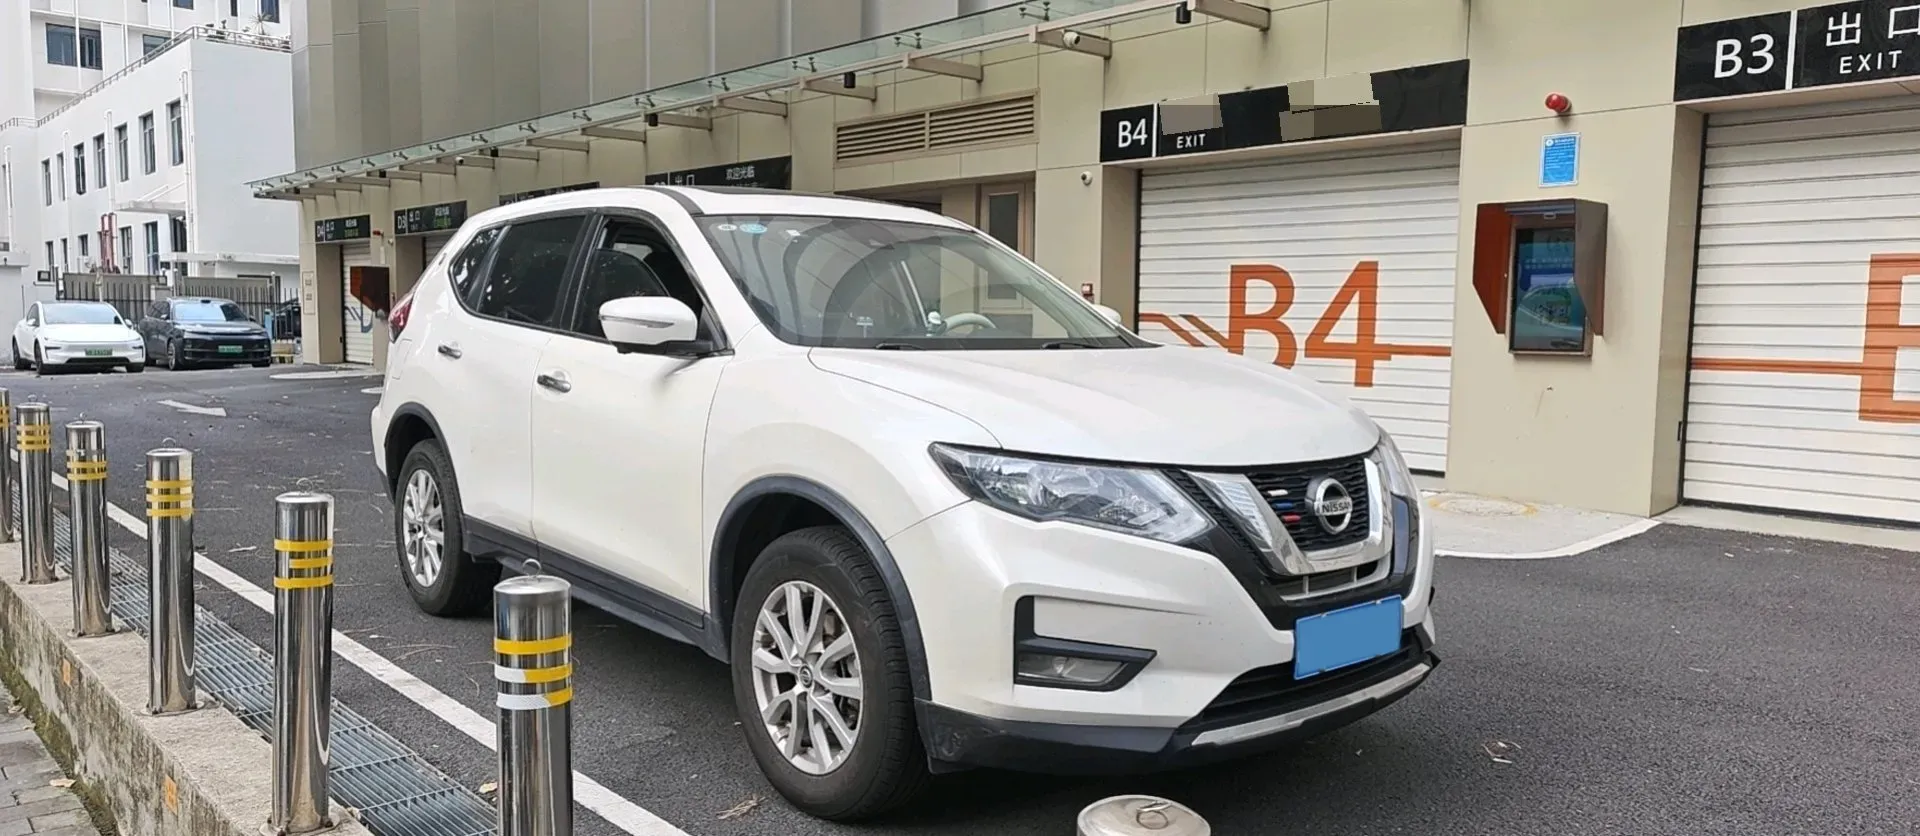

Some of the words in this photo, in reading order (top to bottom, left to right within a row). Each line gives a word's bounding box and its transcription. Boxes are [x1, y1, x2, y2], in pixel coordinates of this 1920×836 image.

[1826, 5, 1920, 47] 出口
[1714, 33, 1774, 78] B3
[1839, 50, 1903, 74] EXIT
[1117, 118, 1149, 148] B4
[1176, 133, 1207, 149] EXIT
[1227, 260, 1391, 388] B4
